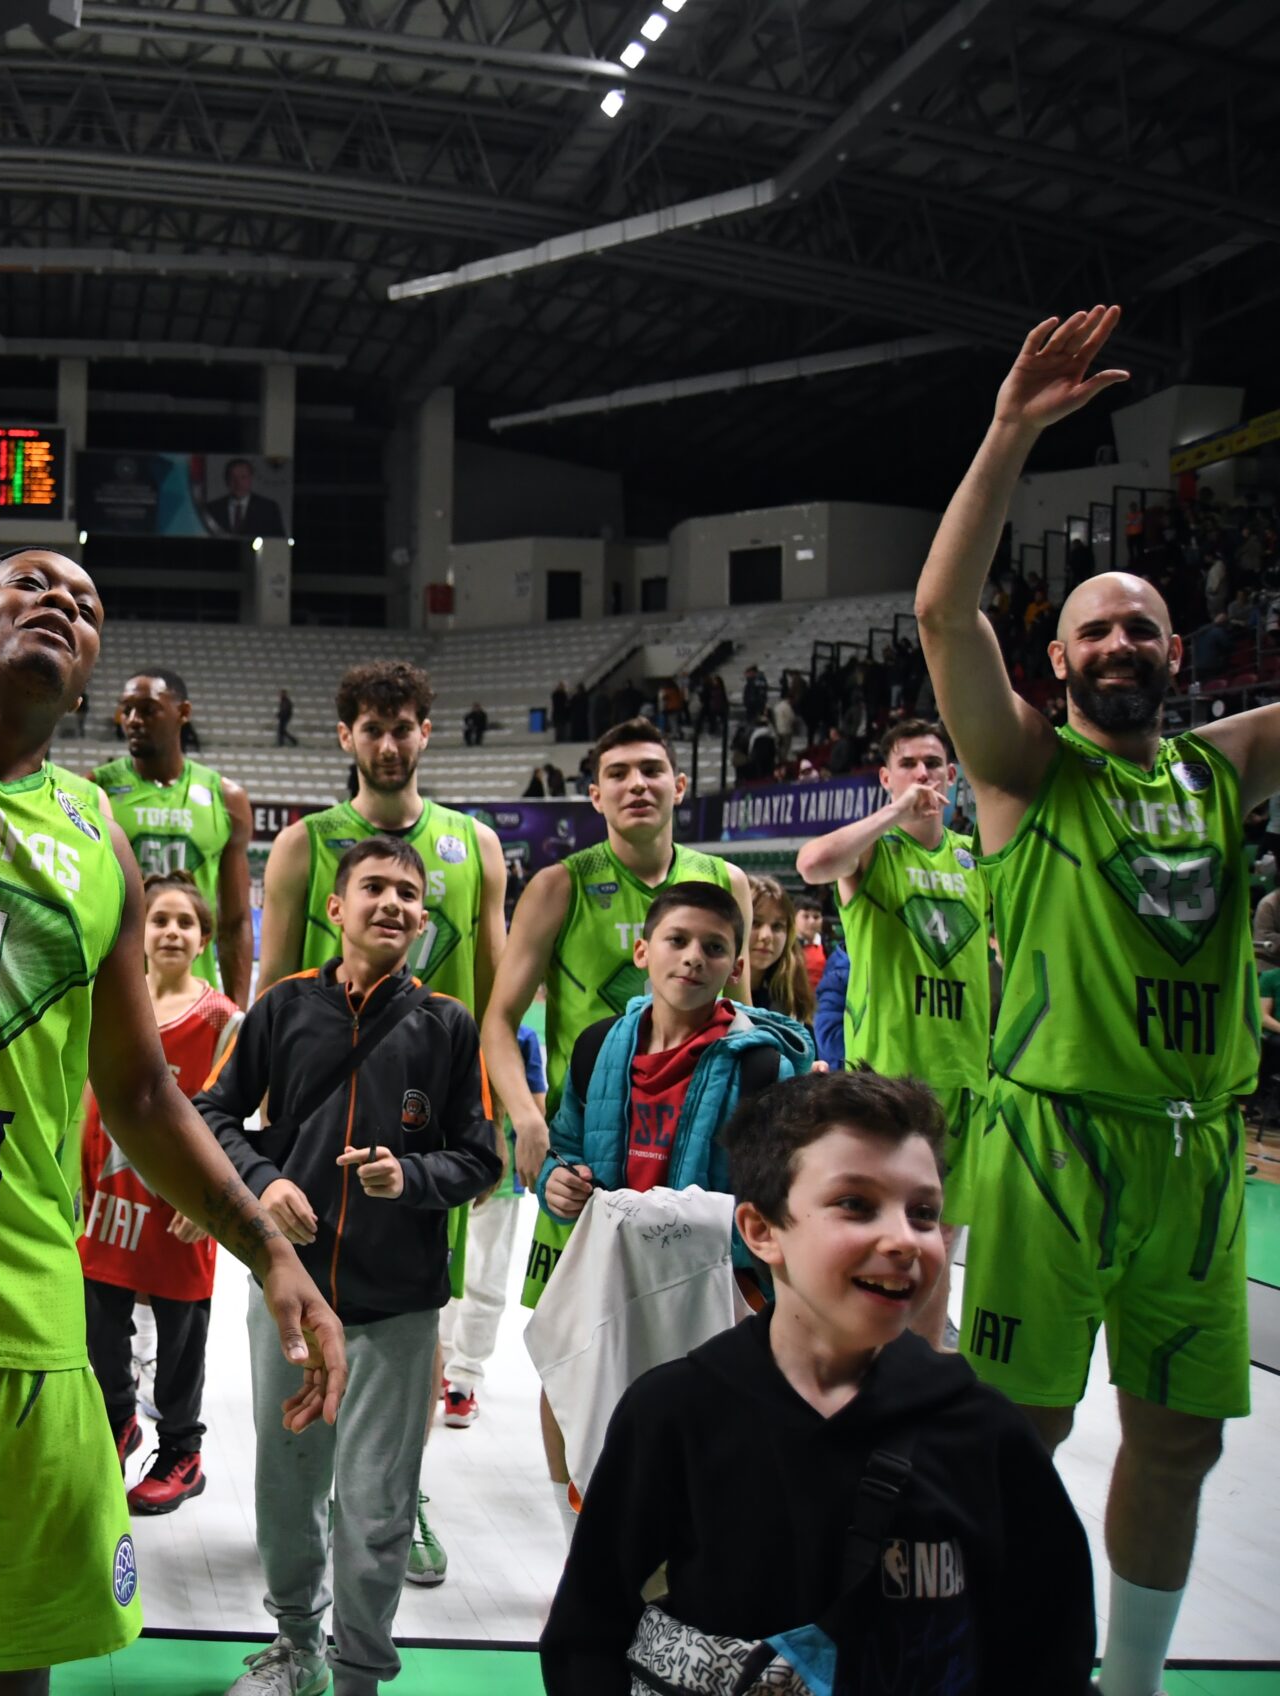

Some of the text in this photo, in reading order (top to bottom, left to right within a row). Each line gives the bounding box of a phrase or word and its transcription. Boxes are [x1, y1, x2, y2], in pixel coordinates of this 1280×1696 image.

[134, 807, 193, 833] TOFAŞ
[906, 867, 967, 897] TOFAŞ
[1131, 856, 1216, 921] 33
[925, 908, 949, 945] 4
[915, 974, 967, 1021] FIAT
[1135, 975, 1220, 1056] FIAT
[84, 1189, 151, 1252] FIAT
[915, 1539, 965, 1598] NBA
